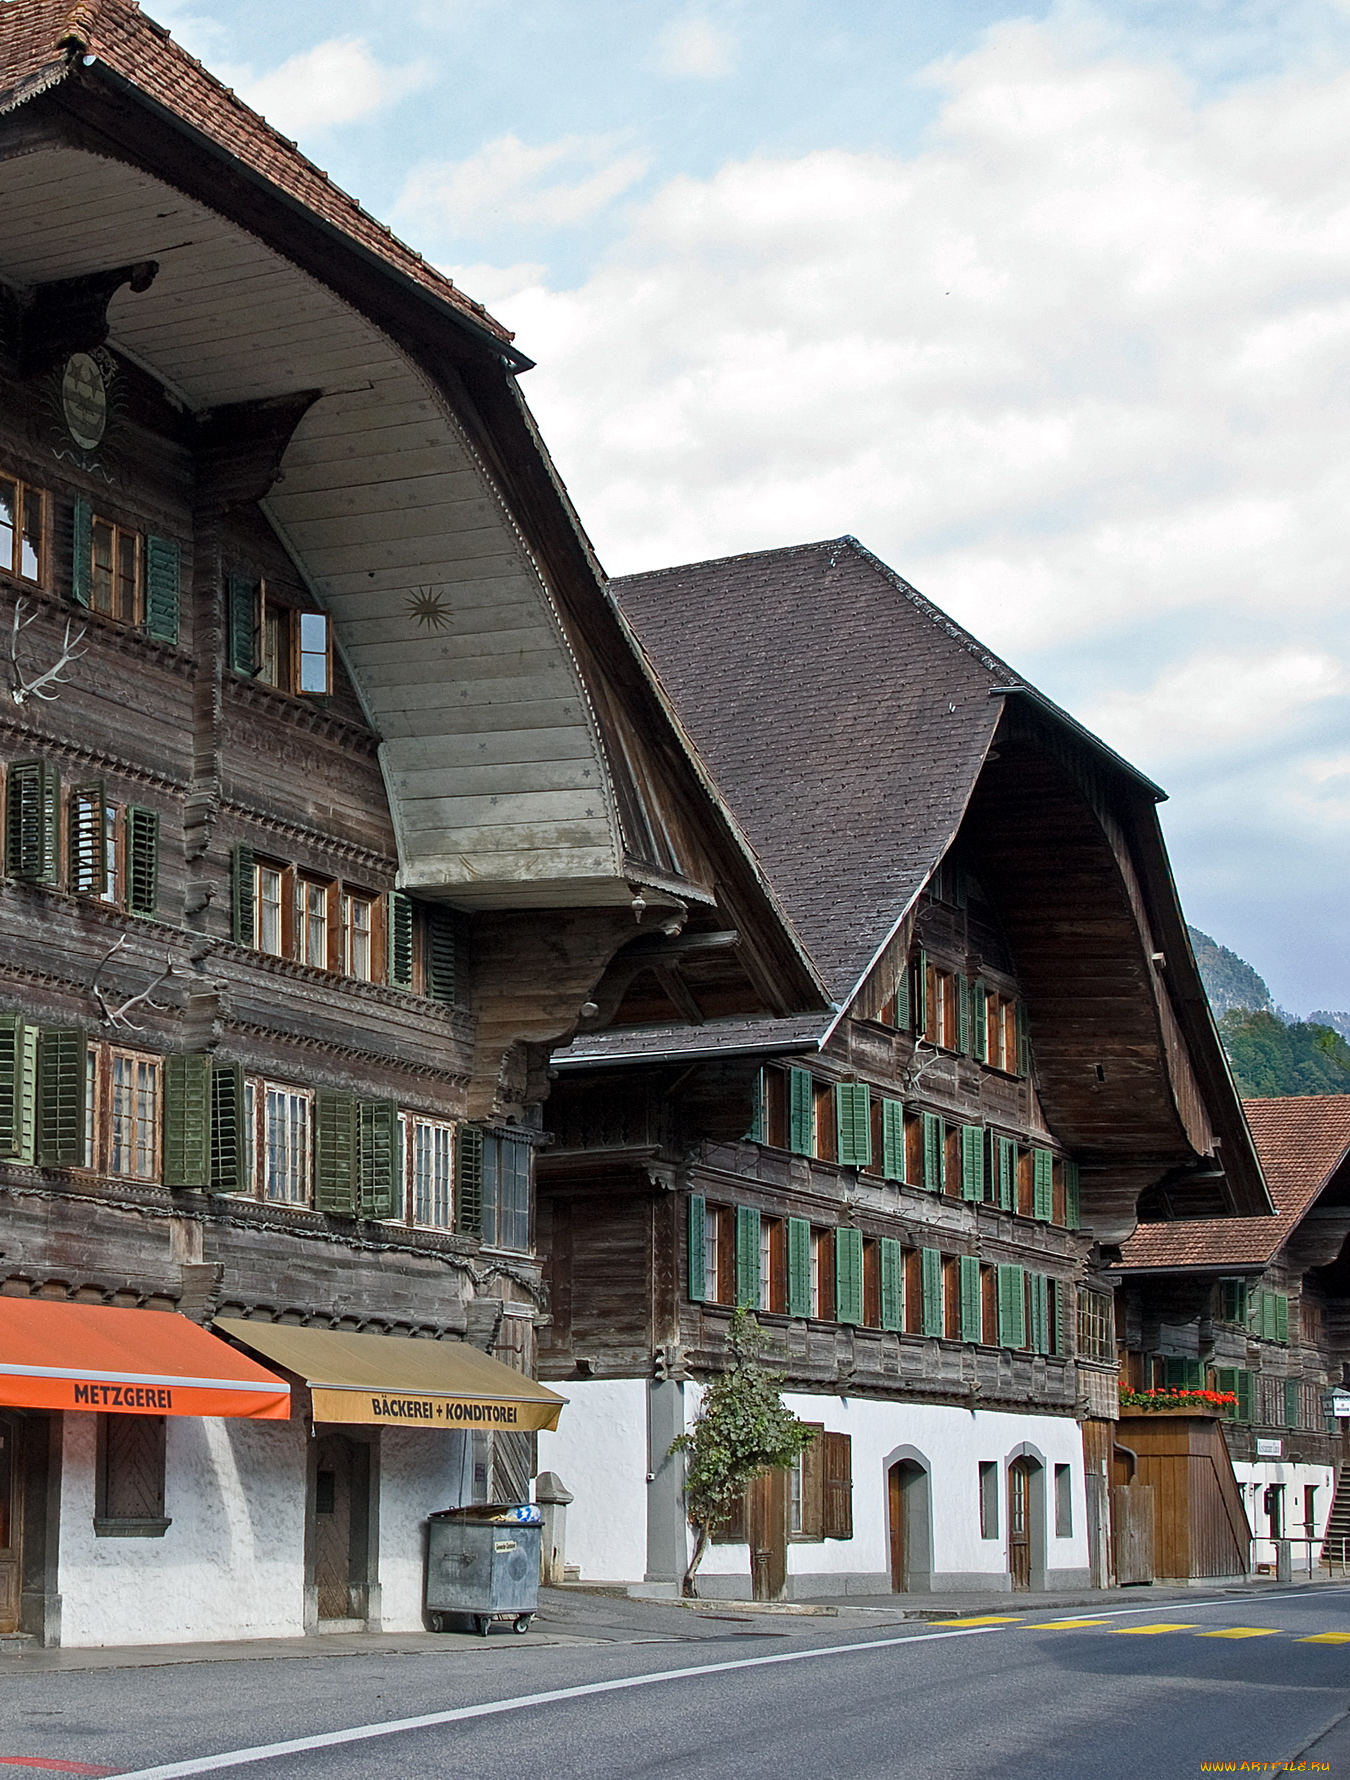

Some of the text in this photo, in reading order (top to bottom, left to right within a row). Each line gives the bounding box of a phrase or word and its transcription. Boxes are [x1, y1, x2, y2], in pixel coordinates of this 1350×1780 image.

[74, 1383, 173, 1409] METZGEREI
[371, 1395, 518, 1424] BÄCKEREI + KONDITOREI
